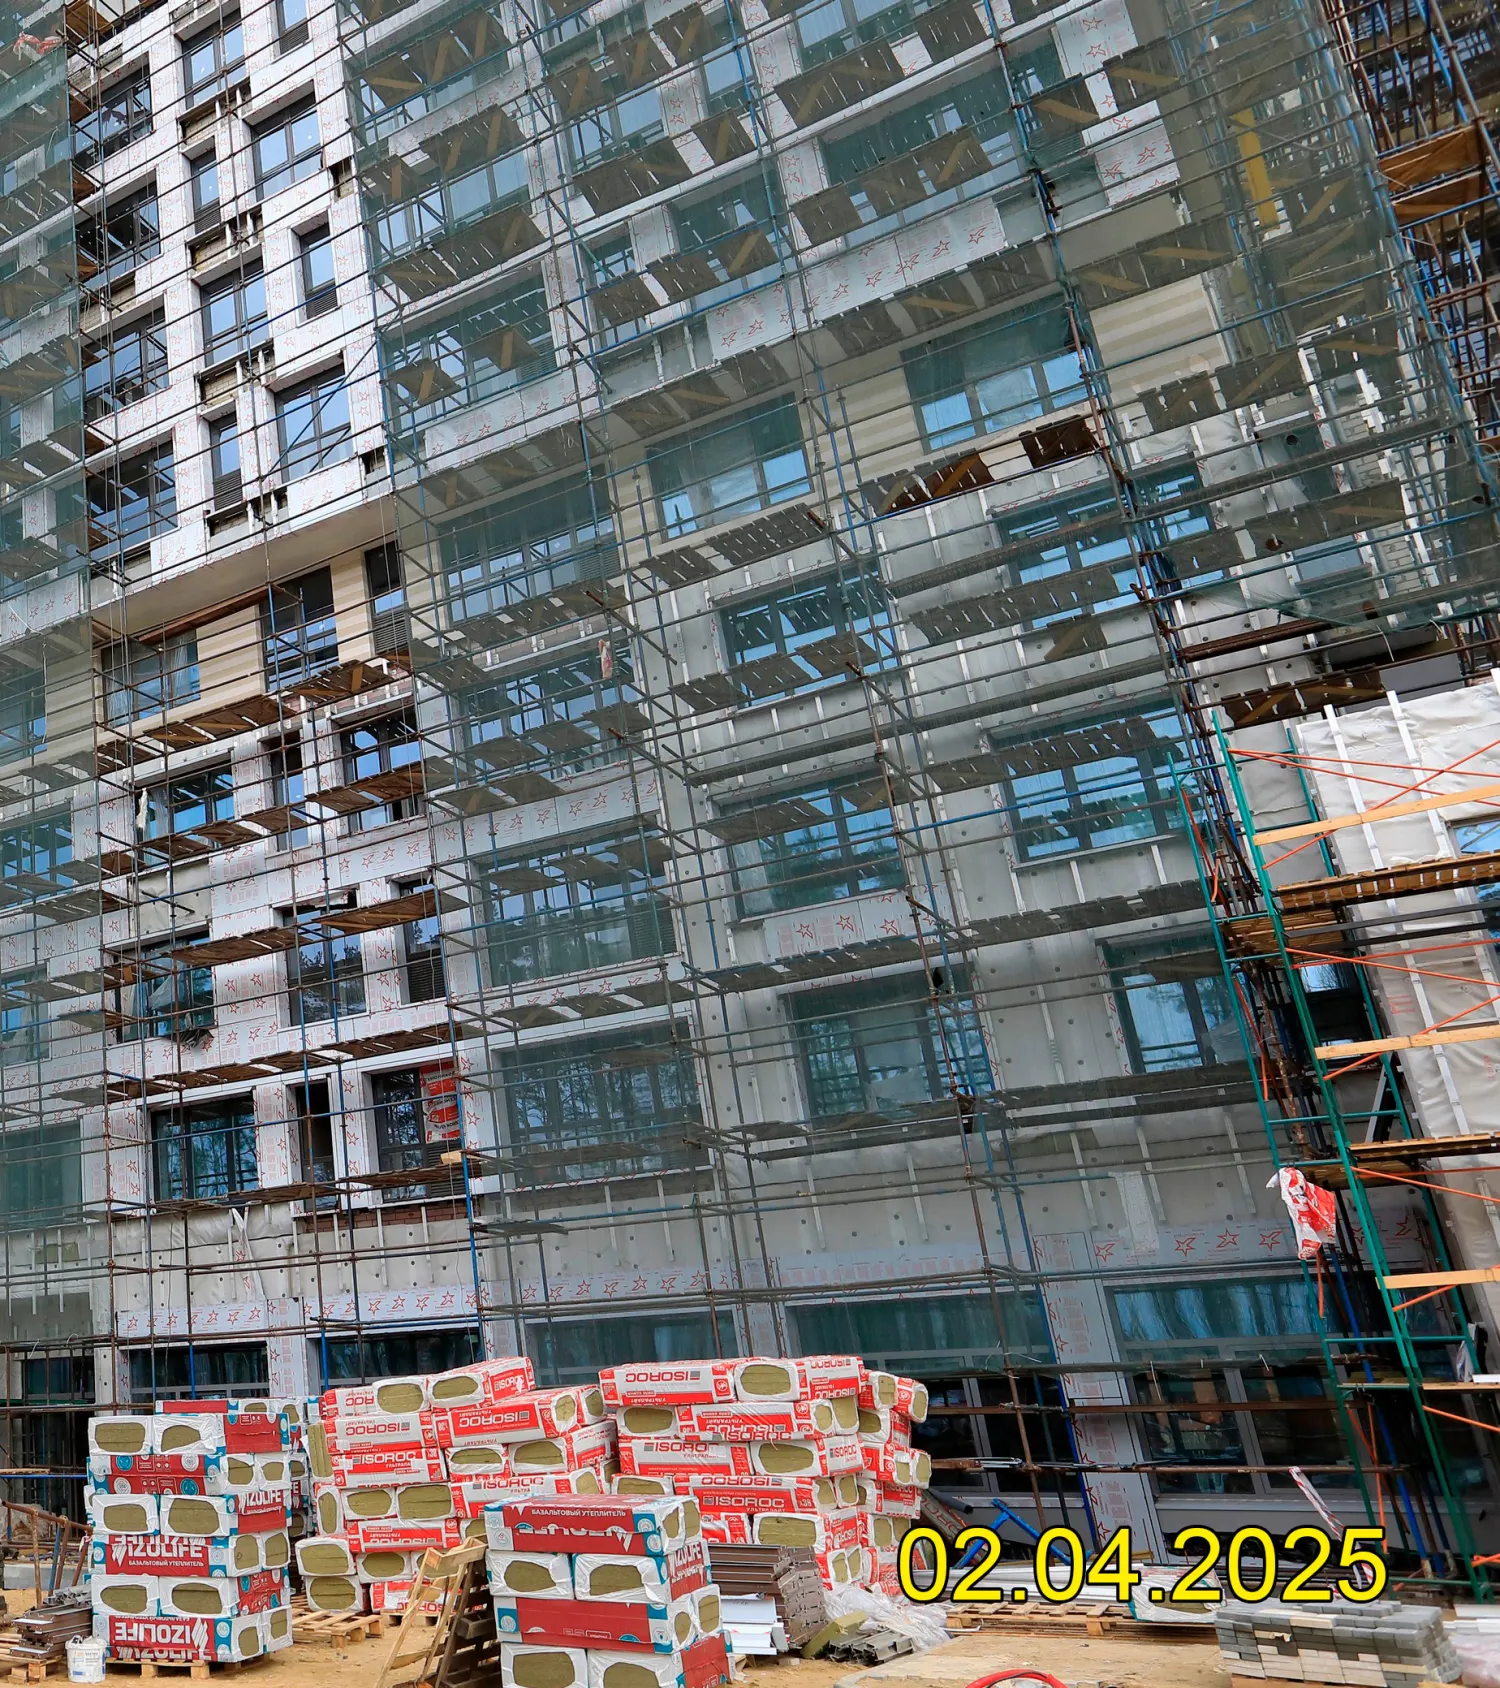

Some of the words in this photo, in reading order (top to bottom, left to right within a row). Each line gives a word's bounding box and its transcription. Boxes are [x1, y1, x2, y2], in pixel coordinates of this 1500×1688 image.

[625, 1371, 689, 1383] ISOROC
[346, 1395, 374, 1406] ROC
[459, 1412, 518, 1428] ISOROC
[345, 1422, 401, 1436] ISOROC
[655, 1442, 719, 1452] ISORO
[361, 1451, 416, 1464] ISOROC
[483, 1476, 544, 1489] ISOROC
[246, 1489, 282, 1507] IZOLIFE
[715, 1496, 785, 1508] ISOROC
[531, 1508, 581, 1516] БАЗАЛЬТОВЫЙ
[127, 1543, 203, 1558] IZOLIFE
[128, 1559, 168, 1567] БАЗАЛЬТОВЫЙ
[115, 1622, 191, 1644] IZOLIFE
